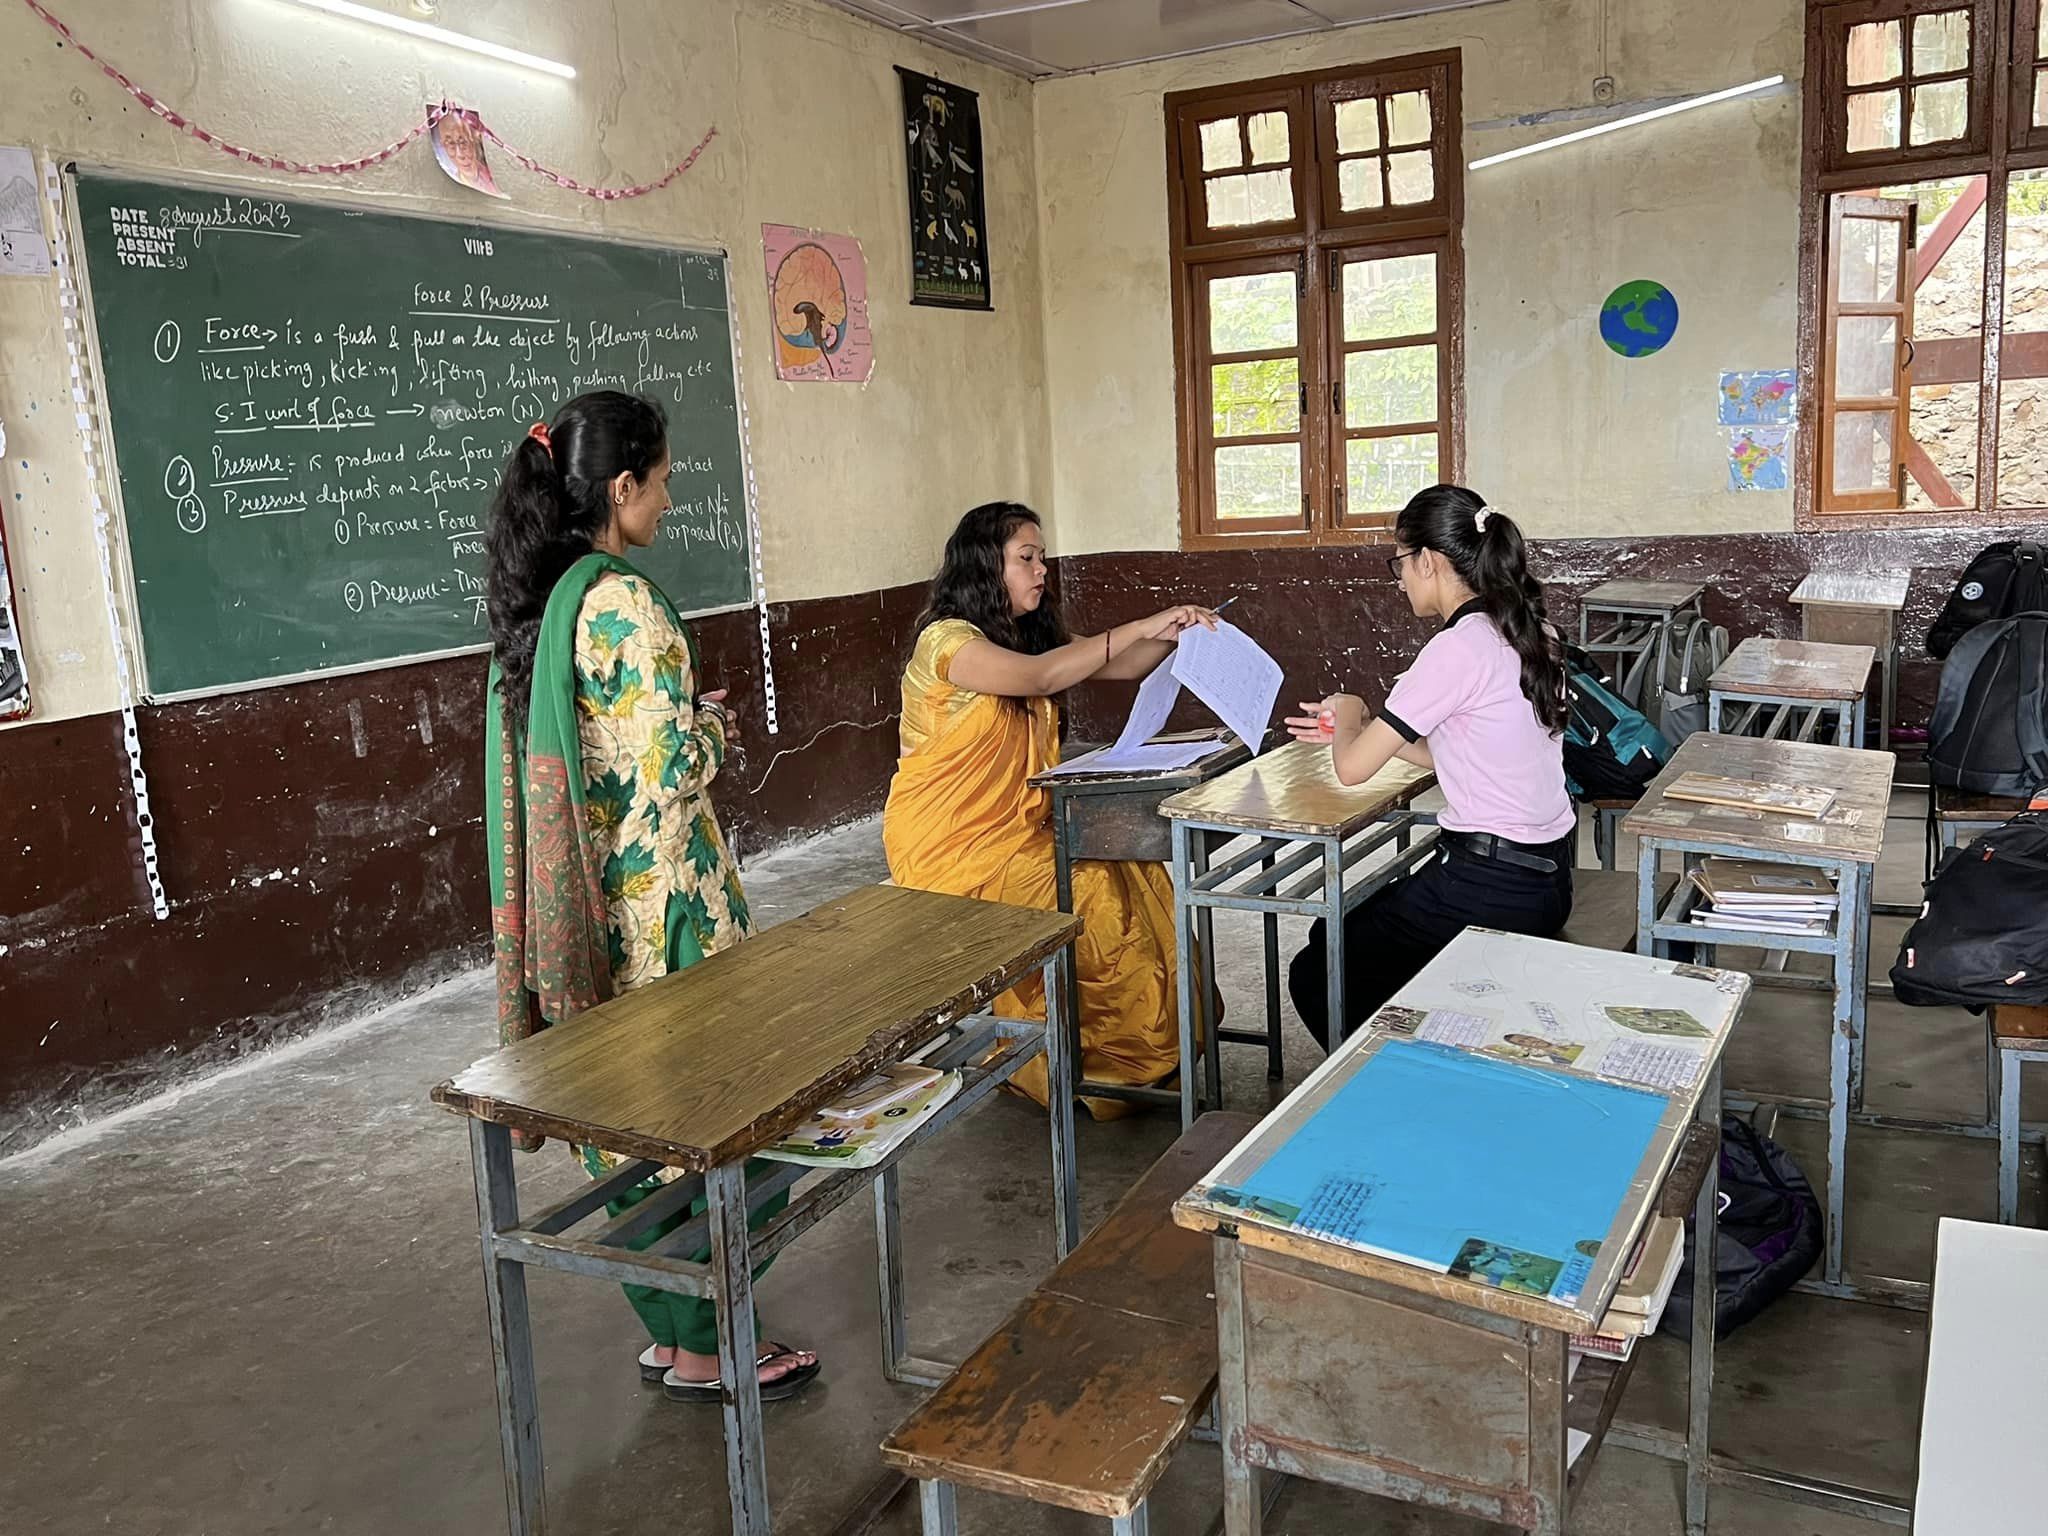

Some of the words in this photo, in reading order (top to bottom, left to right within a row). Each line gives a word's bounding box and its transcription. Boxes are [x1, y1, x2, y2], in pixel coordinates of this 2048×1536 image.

[110, 206, 149, 224] DATE
[240, 198, 291, 229] 2023
[112, 222, 177, 241] PRESENT
[116, 236, 176, 255] ABSENT
[117, 251, 167, 269] TOTAL
[414, 282, 452, 306] Force
[480, 285, 550, 312] Pressure
[205, 317, 262, 344] Force
[286, 318, 302, 344] is
[313, 332, 323, 344] a
[332, 323, 377, 361] push
[472, 325, 501, 347] the
[509, 328, 556, 361] object
[566, 322, 580, 366] by
[587, 321, 652, 367] following
[655, 322, 699, 342] actions
[200, 361, 240, 382] like
[572, 368, 629, 395] pushing
[264, 397, 302, 422] unit
[327, 395, 376, 433] force
[436, 400, 506, 423] newton
[511, 392, 545, 424] (N)
[335, 443, 405, 478] produced
[416, 434, 453, 462] when
[458, 436, 494, 473] force
[670, 455, 713, 473] contact
[223, 489, 309, 515] Pressure
[409, 475, 421, 493] 2
[423, 469, 470, 509] factors
[357, 512, 421, 537] Pressure
[438, 510, 479, 530] Force
[452, 540, 488, 559] Area
[370, 580, 440, 609] Pressure
